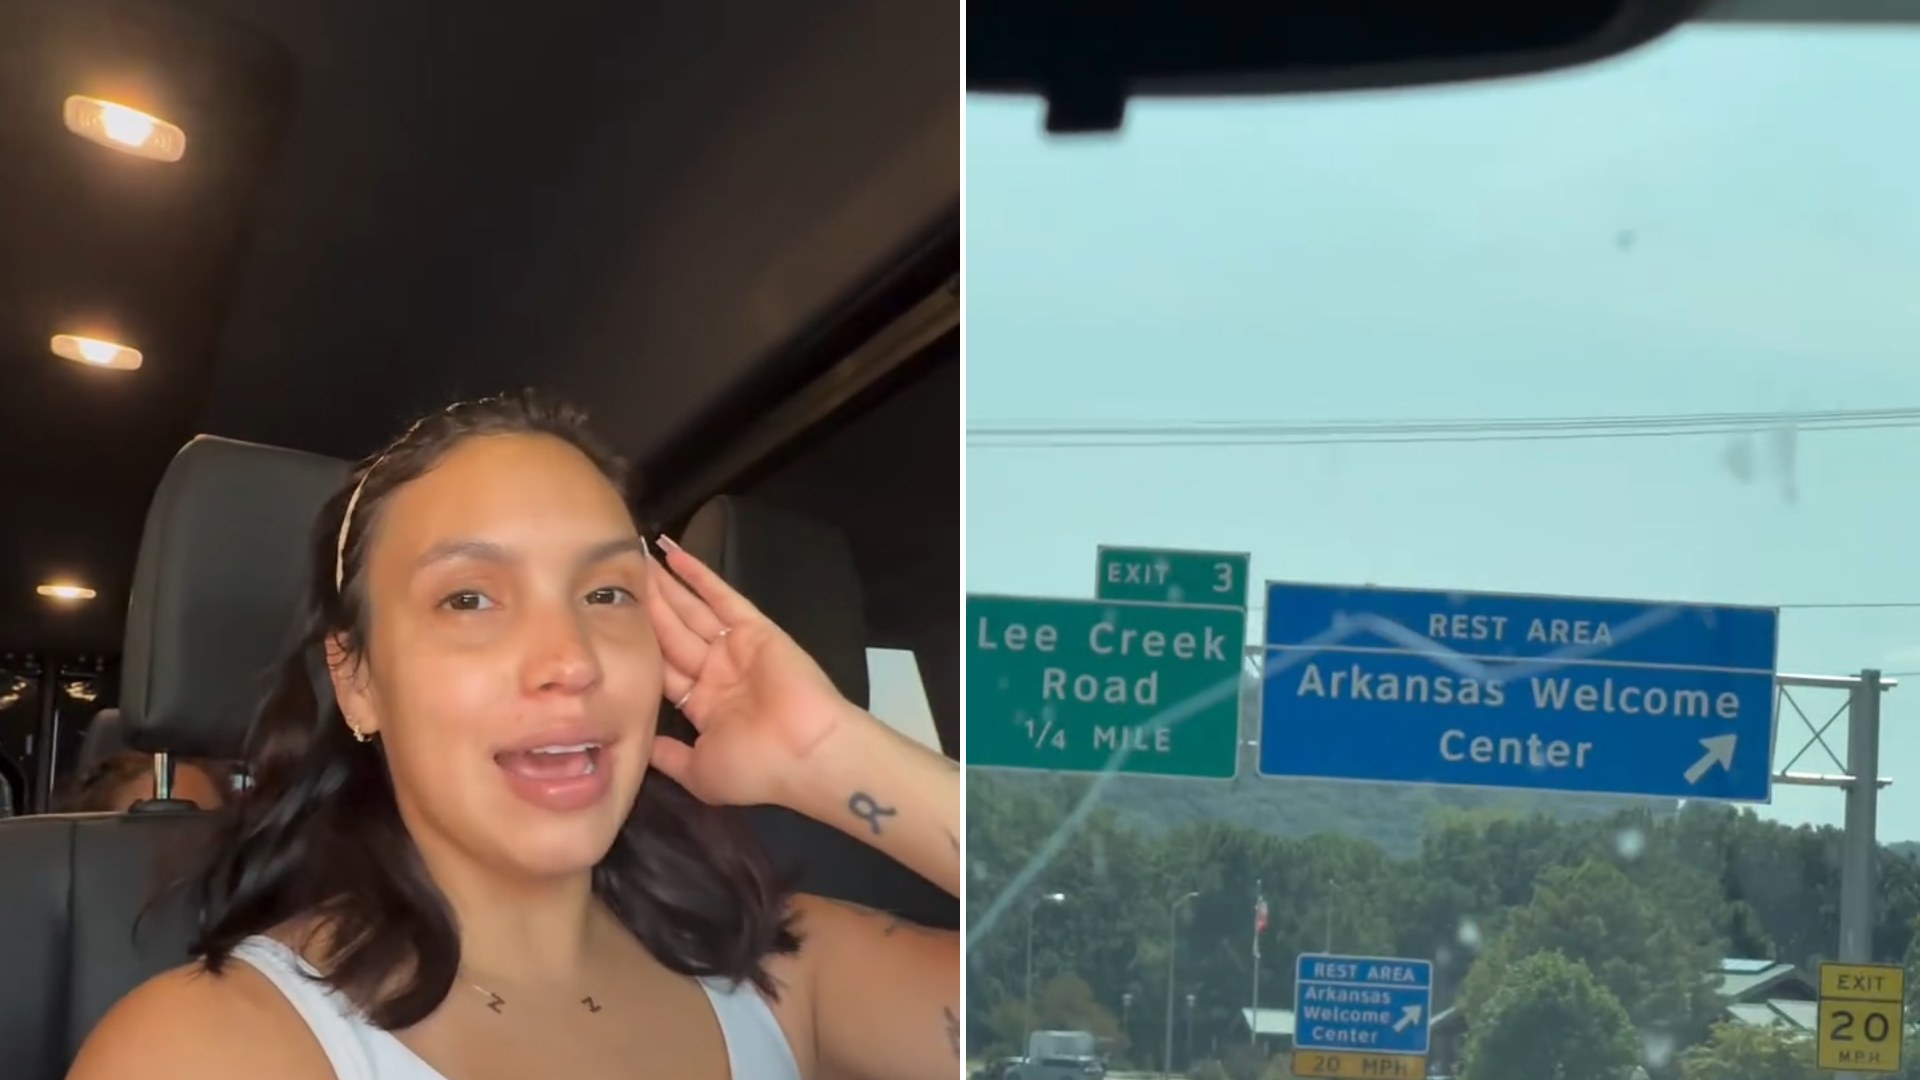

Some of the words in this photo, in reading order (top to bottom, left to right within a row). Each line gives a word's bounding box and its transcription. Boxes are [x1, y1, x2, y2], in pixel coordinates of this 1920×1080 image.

[1107, 562, 1169, 585] EXIT
[1212, 562, 1234, 592] 3
[977, 617, 1058, 651] Lee
[1089, 622, 1226, 661] Creek
[1429, 613, 1507, 640] REST
[1527, 618, 1613, 646] AREA
[1042, 667, 1159, 705] Road
[1297, 664, 1505, 706] Arkansas
[1531, 677, 1740, 719] Welcome
[1025, 719, 1066, 750] 1/4
[1093, 725, 1171, 752] MILE
[1439, 730, 1592, 768] Center
[1314, 962, 1358, 979] REST
[1367, 966, 1415, 982] AREA
[1837, 974, 1886, 992] EXIT
[1305, 986, 1392, 1005] Arkansas
[1303, 1005, 1391, 1024] Welcome
[1830, 1010, 1889, 1042] 20
[1312, 1026, 1379, 1043] Center
[1312, 1055, 1340, 1072] 20
[1361, 1058, 1407, 1076] MPH
